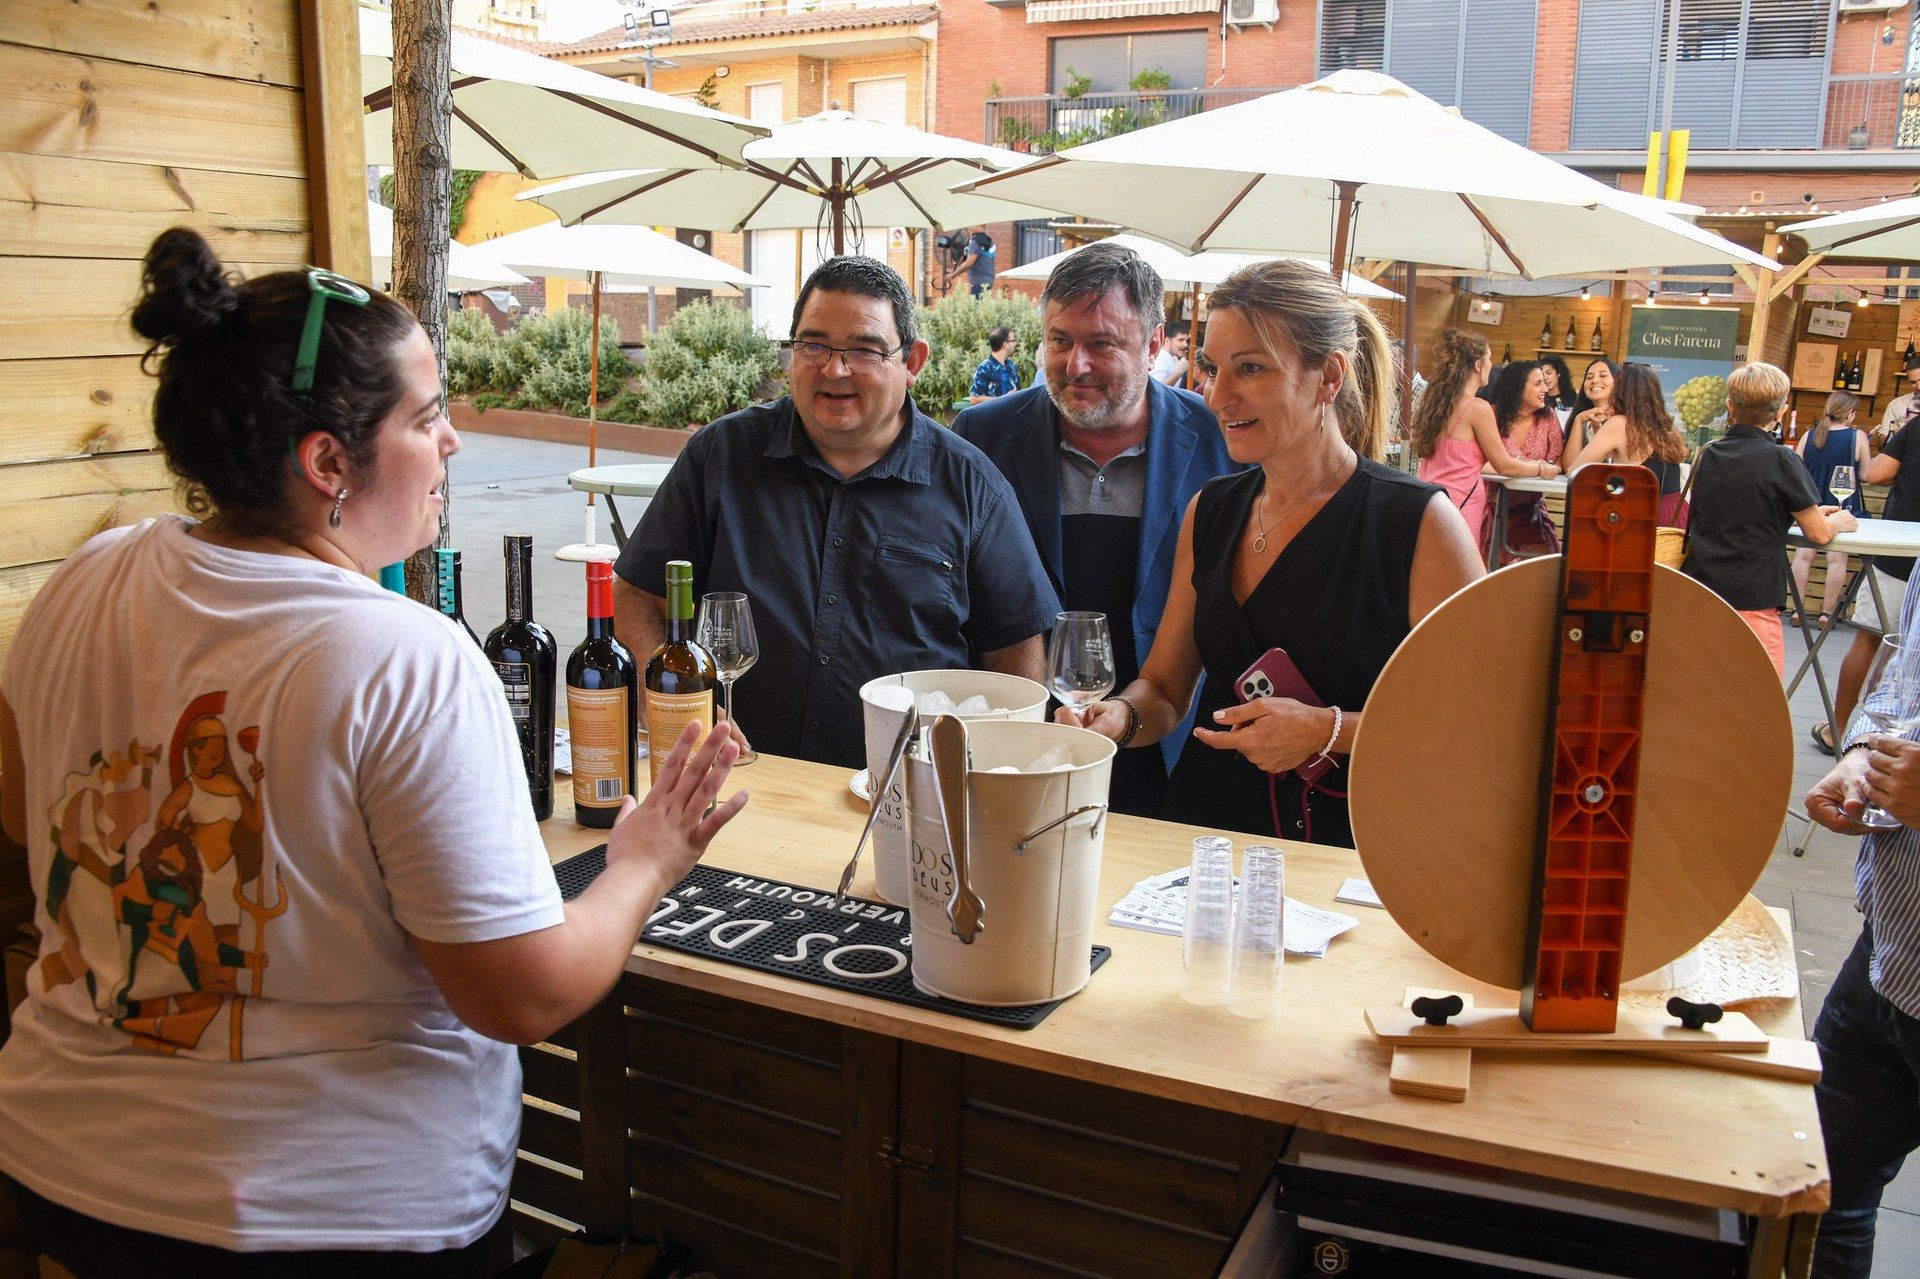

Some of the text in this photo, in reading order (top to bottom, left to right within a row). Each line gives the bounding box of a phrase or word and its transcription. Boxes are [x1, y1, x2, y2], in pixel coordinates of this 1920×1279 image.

[1642, 332, 1721, 349] Clos Farena
[911, 839, 952, 876] DOS
[912, 867, 952, 896] DÉUS
[725, 876, 905, 925] VERMOUTH
[645, 897, 908, 979] OS DÉU
